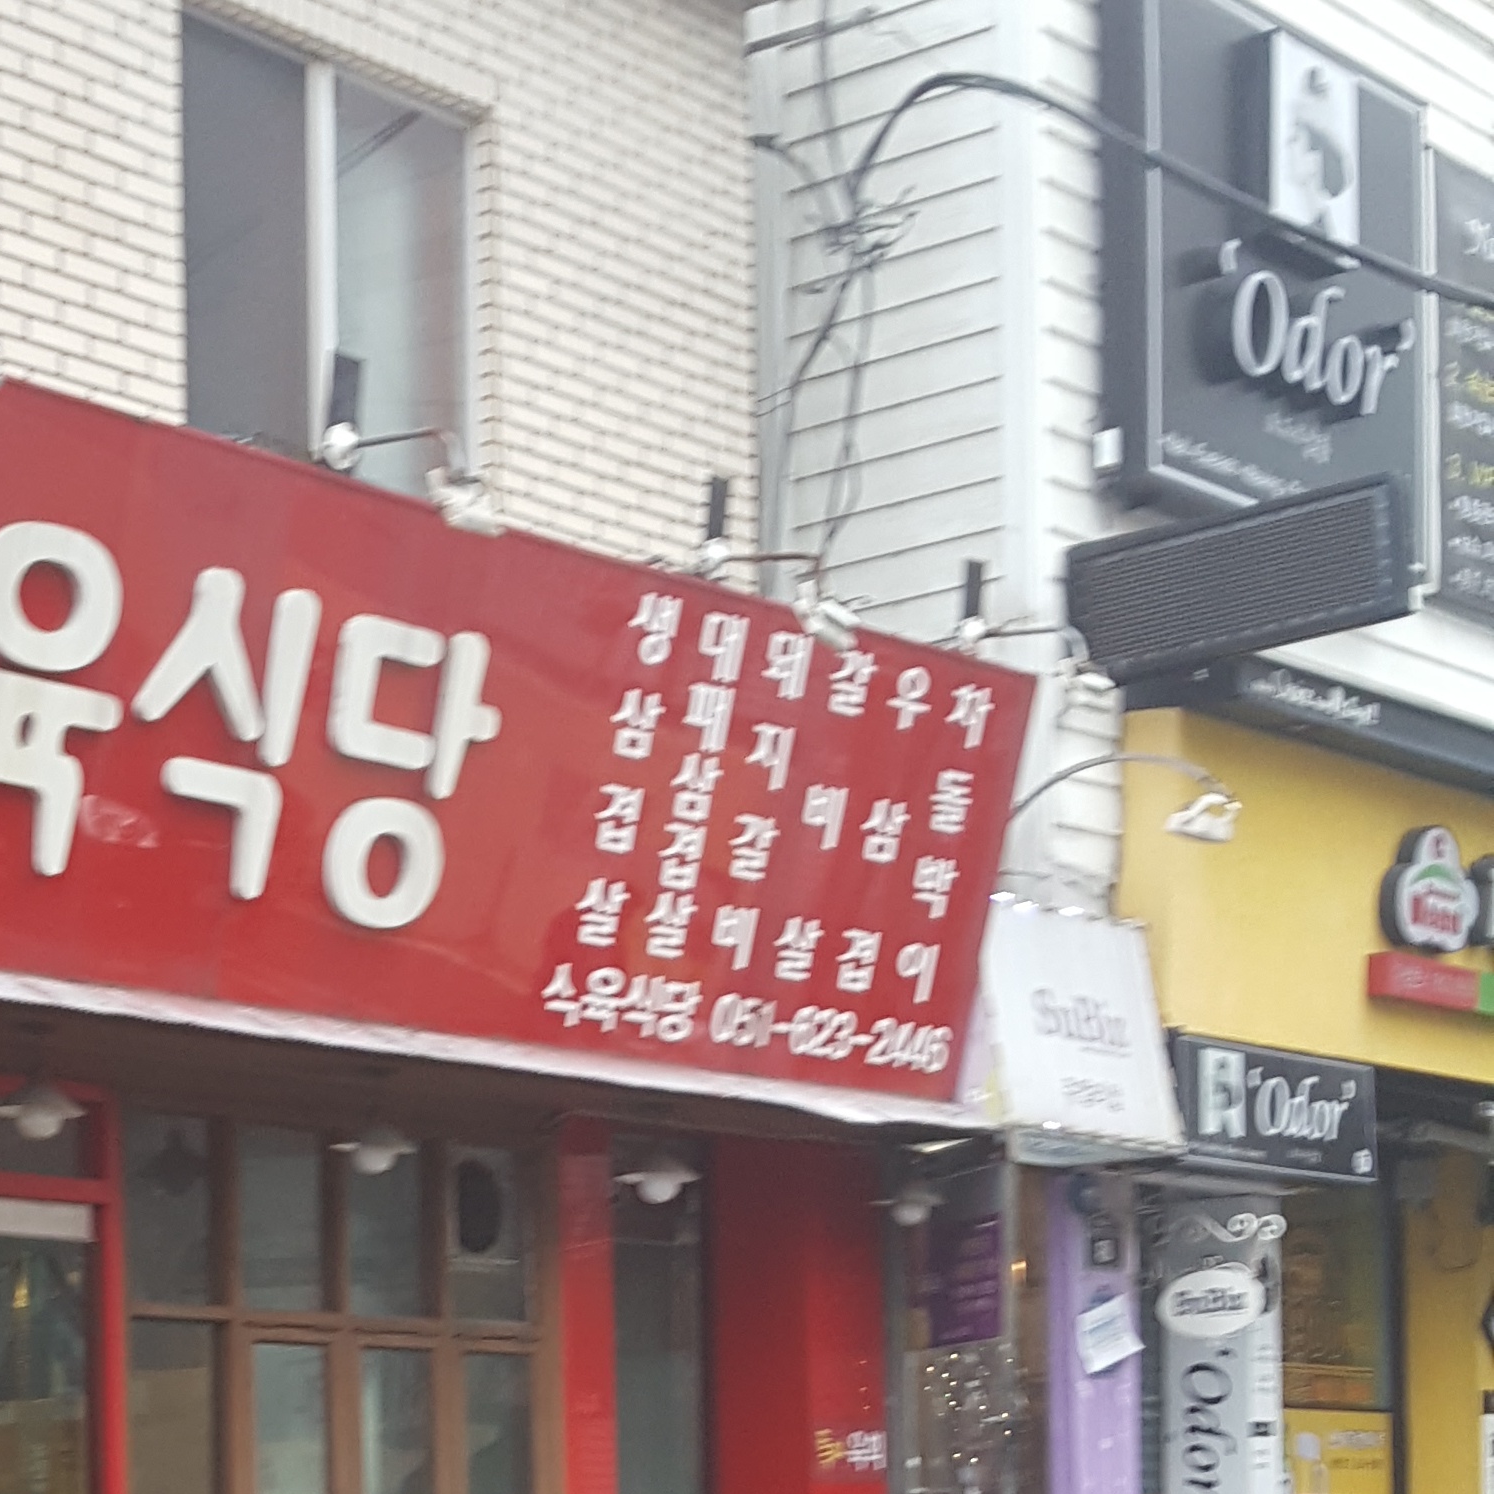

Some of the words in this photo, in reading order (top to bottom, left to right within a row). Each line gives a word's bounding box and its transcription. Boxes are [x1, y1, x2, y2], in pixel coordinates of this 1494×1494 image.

[575, 592, 683, 947] 생삼겹살
[644, 610, 750, 958] 대패삼겹살
[711, 630, 813, 970] 돼지갈비
[774, 650, 877, 982] 갈비살
[836, 666, 931, 992] 우삼겹
[895, 683, 995, 1004] 차돌박이
